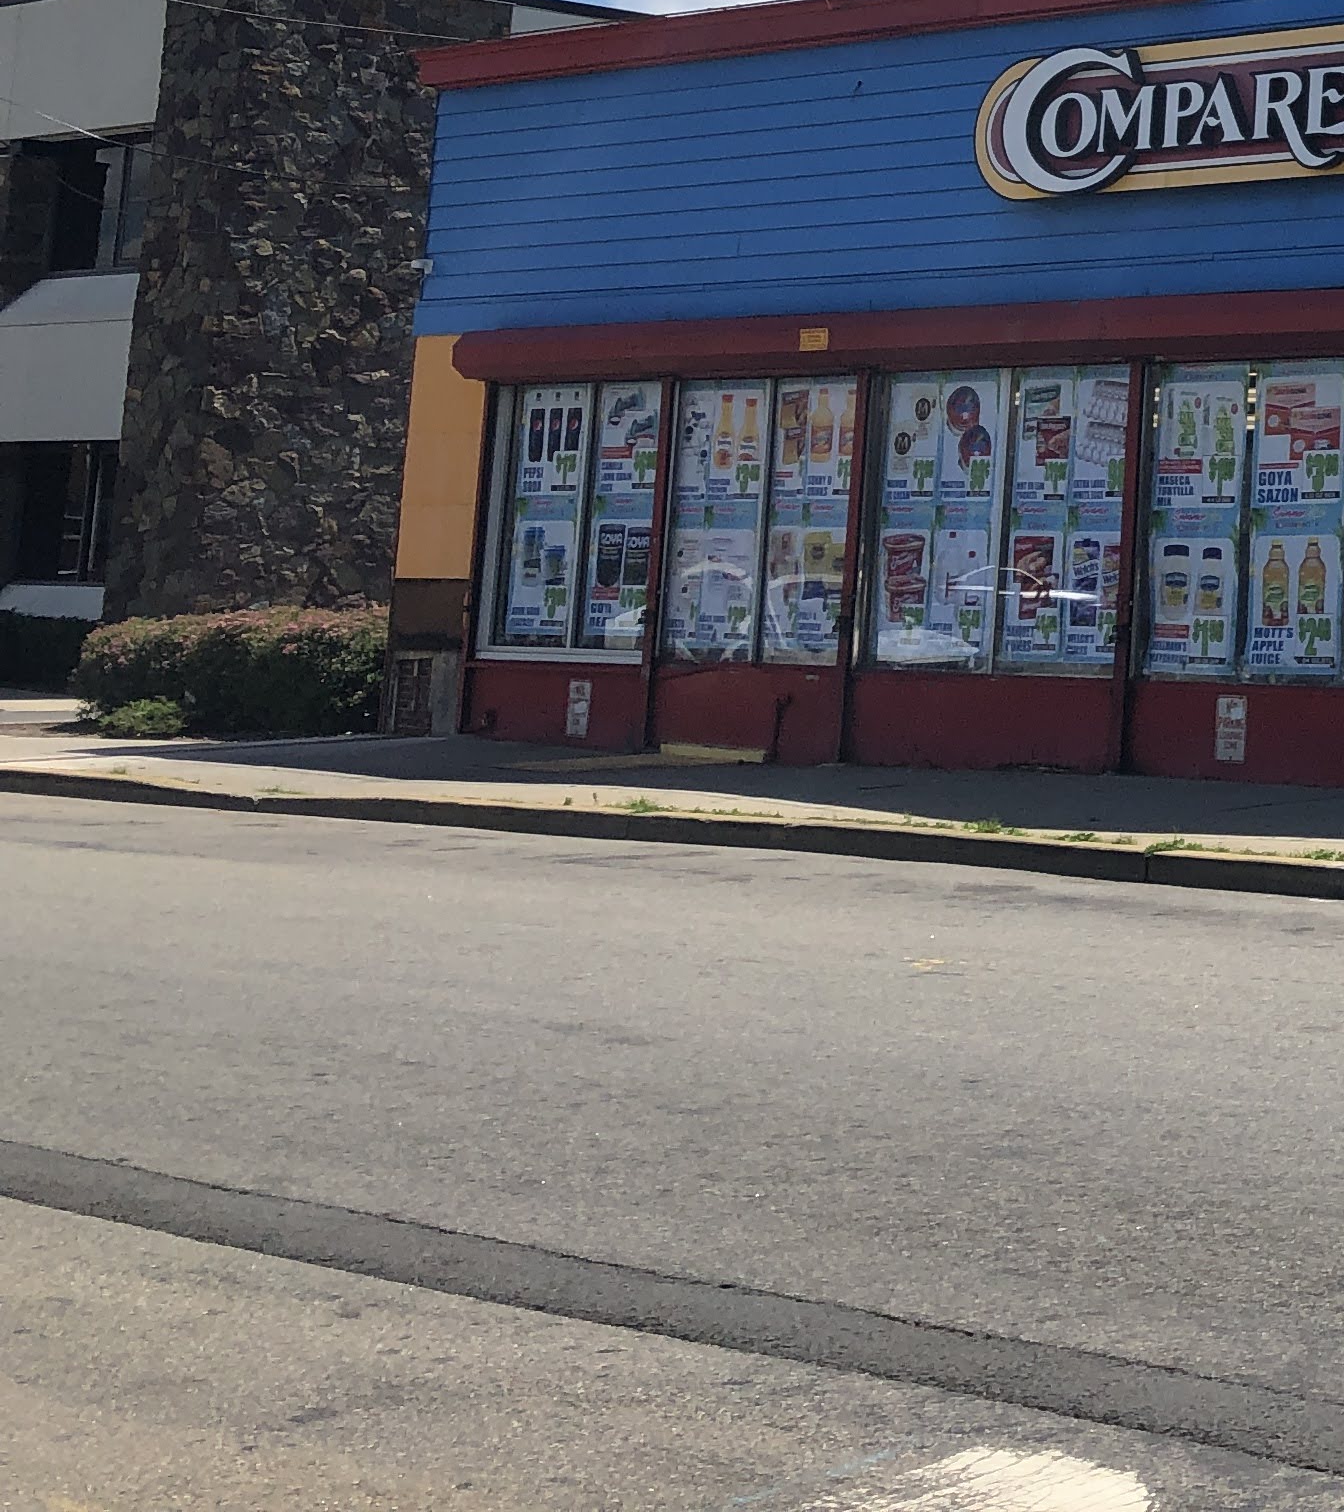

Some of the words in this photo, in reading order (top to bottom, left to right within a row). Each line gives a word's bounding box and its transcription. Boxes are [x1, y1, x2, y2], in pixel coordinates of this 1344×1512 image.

[1258, 471, 1292, 486] GOYA
[1257, 487, 1298, 503] SAZON
[1254, 627, 1293, 638] MOTT'S
[1251, 640, 1284, 651] APPLE
[1250, 653, 1280, 664] JUICE
